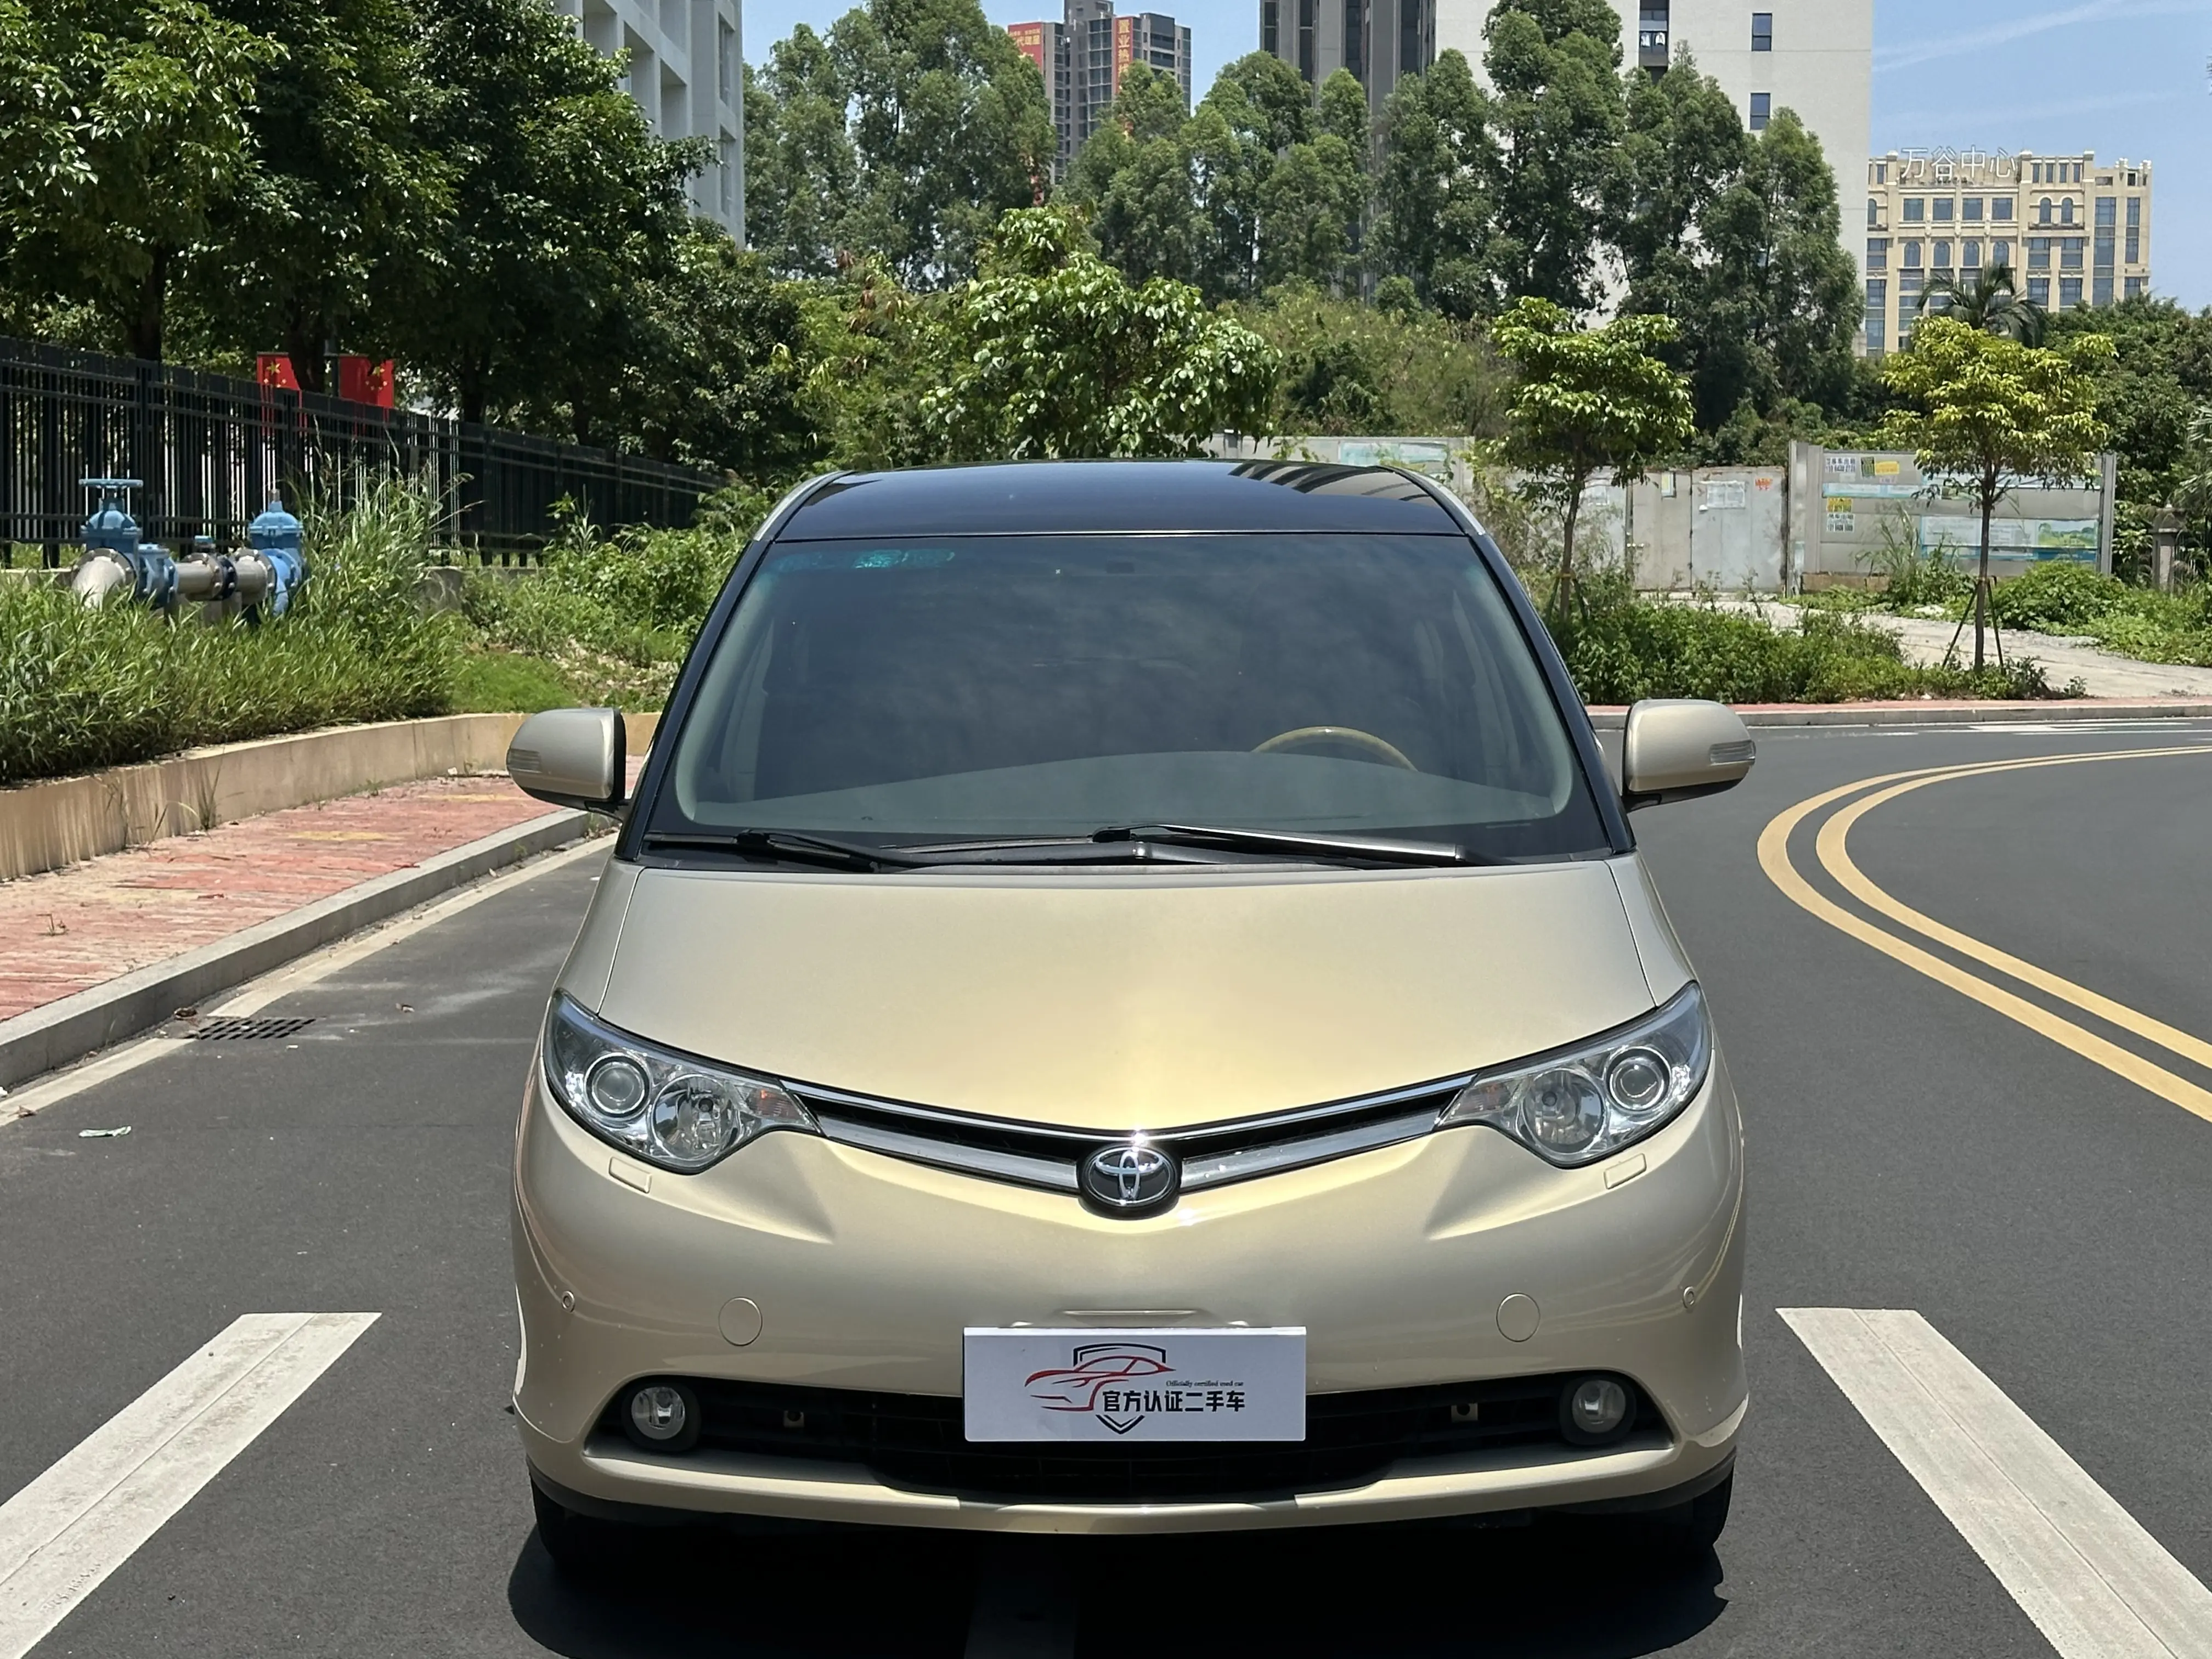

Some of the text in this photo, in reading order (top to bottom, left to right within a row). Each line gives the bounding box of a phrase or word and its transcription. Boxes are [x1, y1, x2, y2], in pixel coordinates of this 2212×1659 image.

[1901, 144, 2017, 179] 万谷中心
[1166, 1380, 1193, 1388] Officially
[1102, 1390, 1245, 1412] 官方认证二手车
